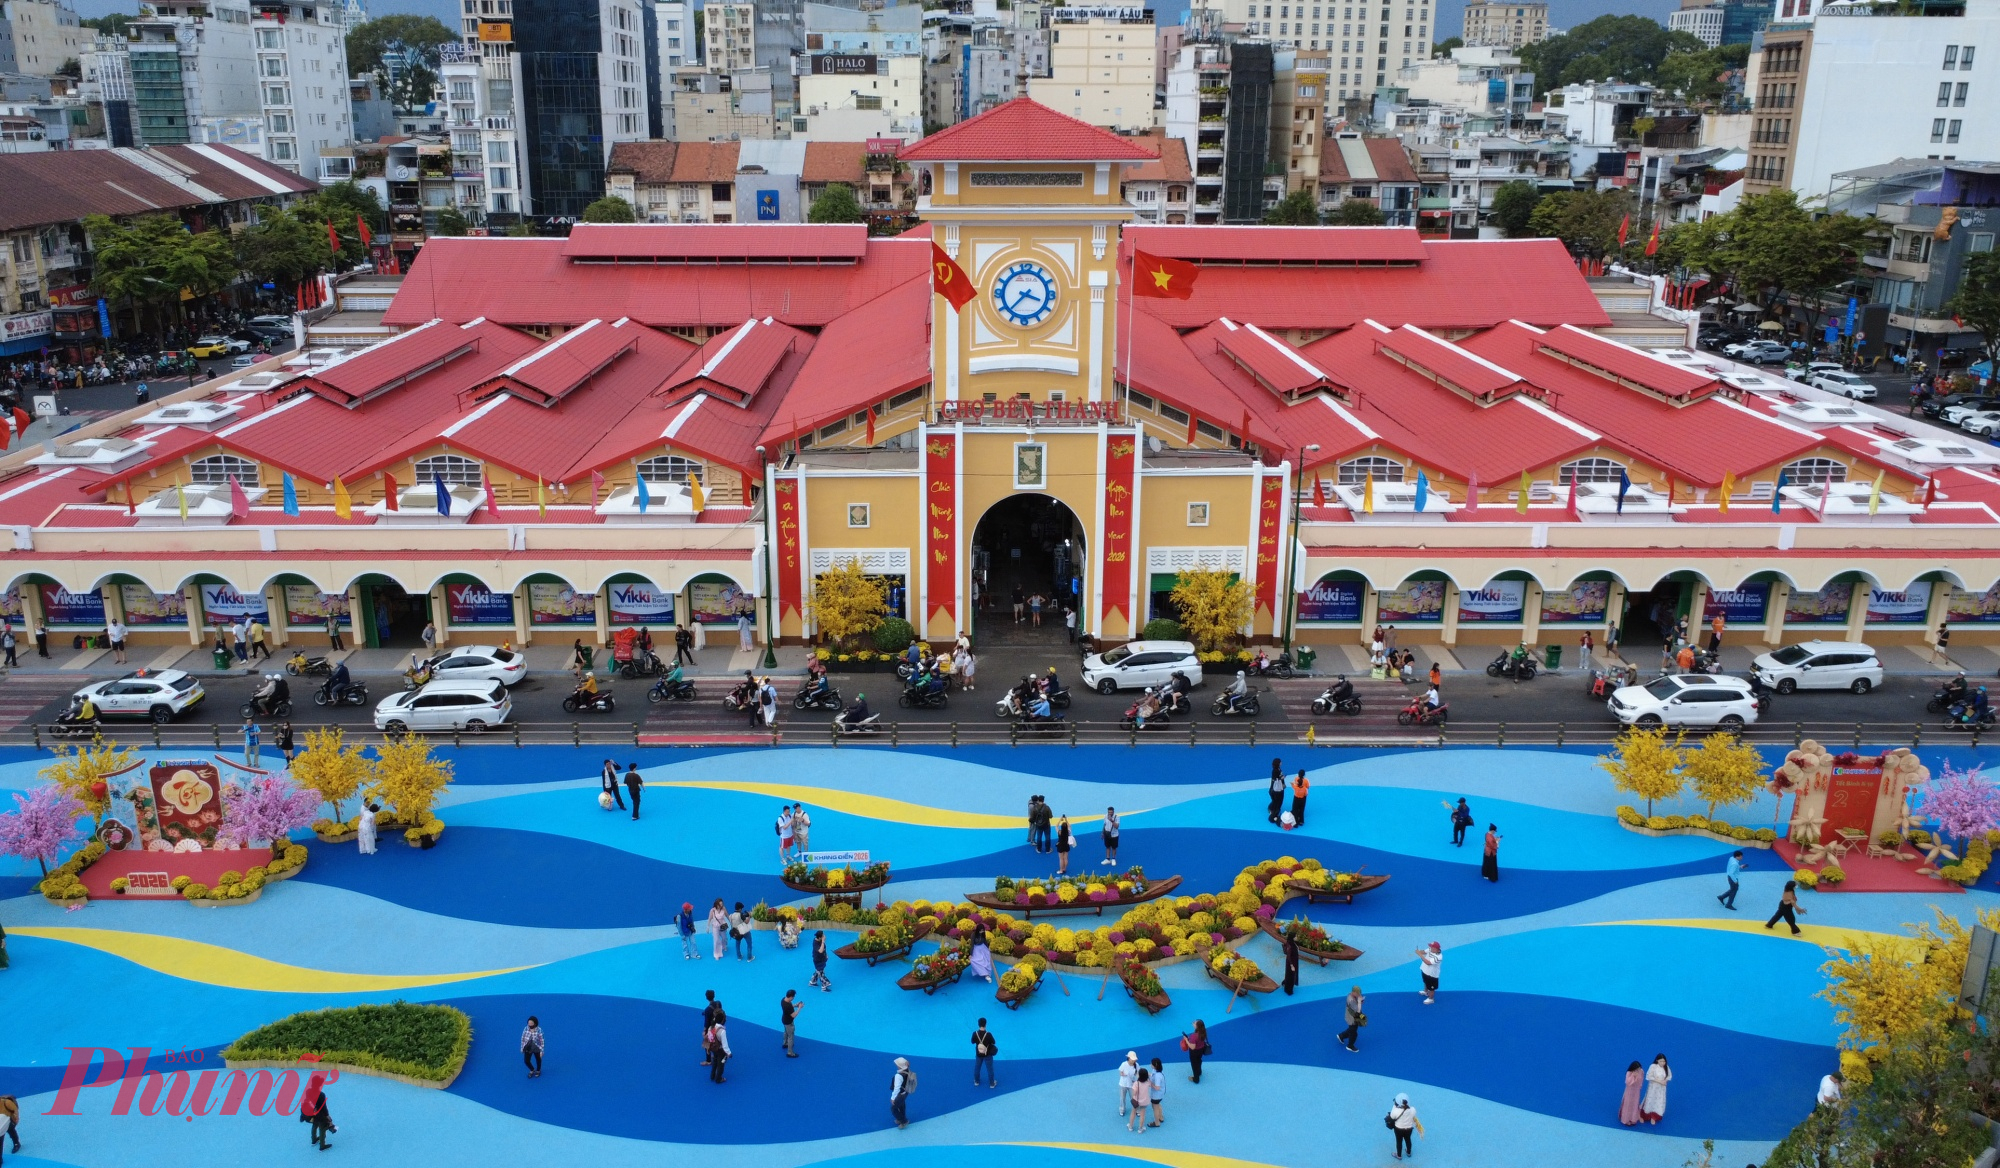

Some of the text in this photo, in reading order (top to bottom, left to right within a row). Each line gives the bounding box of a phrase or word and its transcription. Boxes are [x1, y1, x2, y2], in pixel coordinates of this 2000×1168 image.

[1056, 9, 1073, 18] BỆNH
[1075, 8, 1088, 18] VIỆN
[1108, 8, 1117, 18] MỸ
[1852, 6, 1873, 16] BAR
[440, 53, 460, 62] SPA
[837, 58, 866, 67] HALO
[761, 206, 776, 216] PNJ
[1019, 263, 1032, 272] 12
[994, 288, 1003, 298] 9
[1048, 290, 1056, 300] 3
[16, 317, 31, 330] HÀ
[1020, 317, 1028, 326] 6
[941, 392, 1119, 421] CHỢ BẾN THÀNH
[931, 481, 951, 493] Chúc
[780, 517, 796, 539] Xuân
[1107, 552, 1126, 562] 2026
[47, 585, 84, 604] Vikki
[207, 586, 244, 604] Vikki
[452, 585, 489, 603] Vikki
[614, 584, 650, 603] Vikki
[1304, 582, 1340, 601] Vikki
[1467, 589, 1500, 601] Vikki
[1709, 590, 1745, 603] Vikki
[1872, 590, 1907, 602] Vikki
[1832, 790, 1848, 807] 2
[854, 852, 868, 861] 2026
[128, 874, 168, 887] 2026
